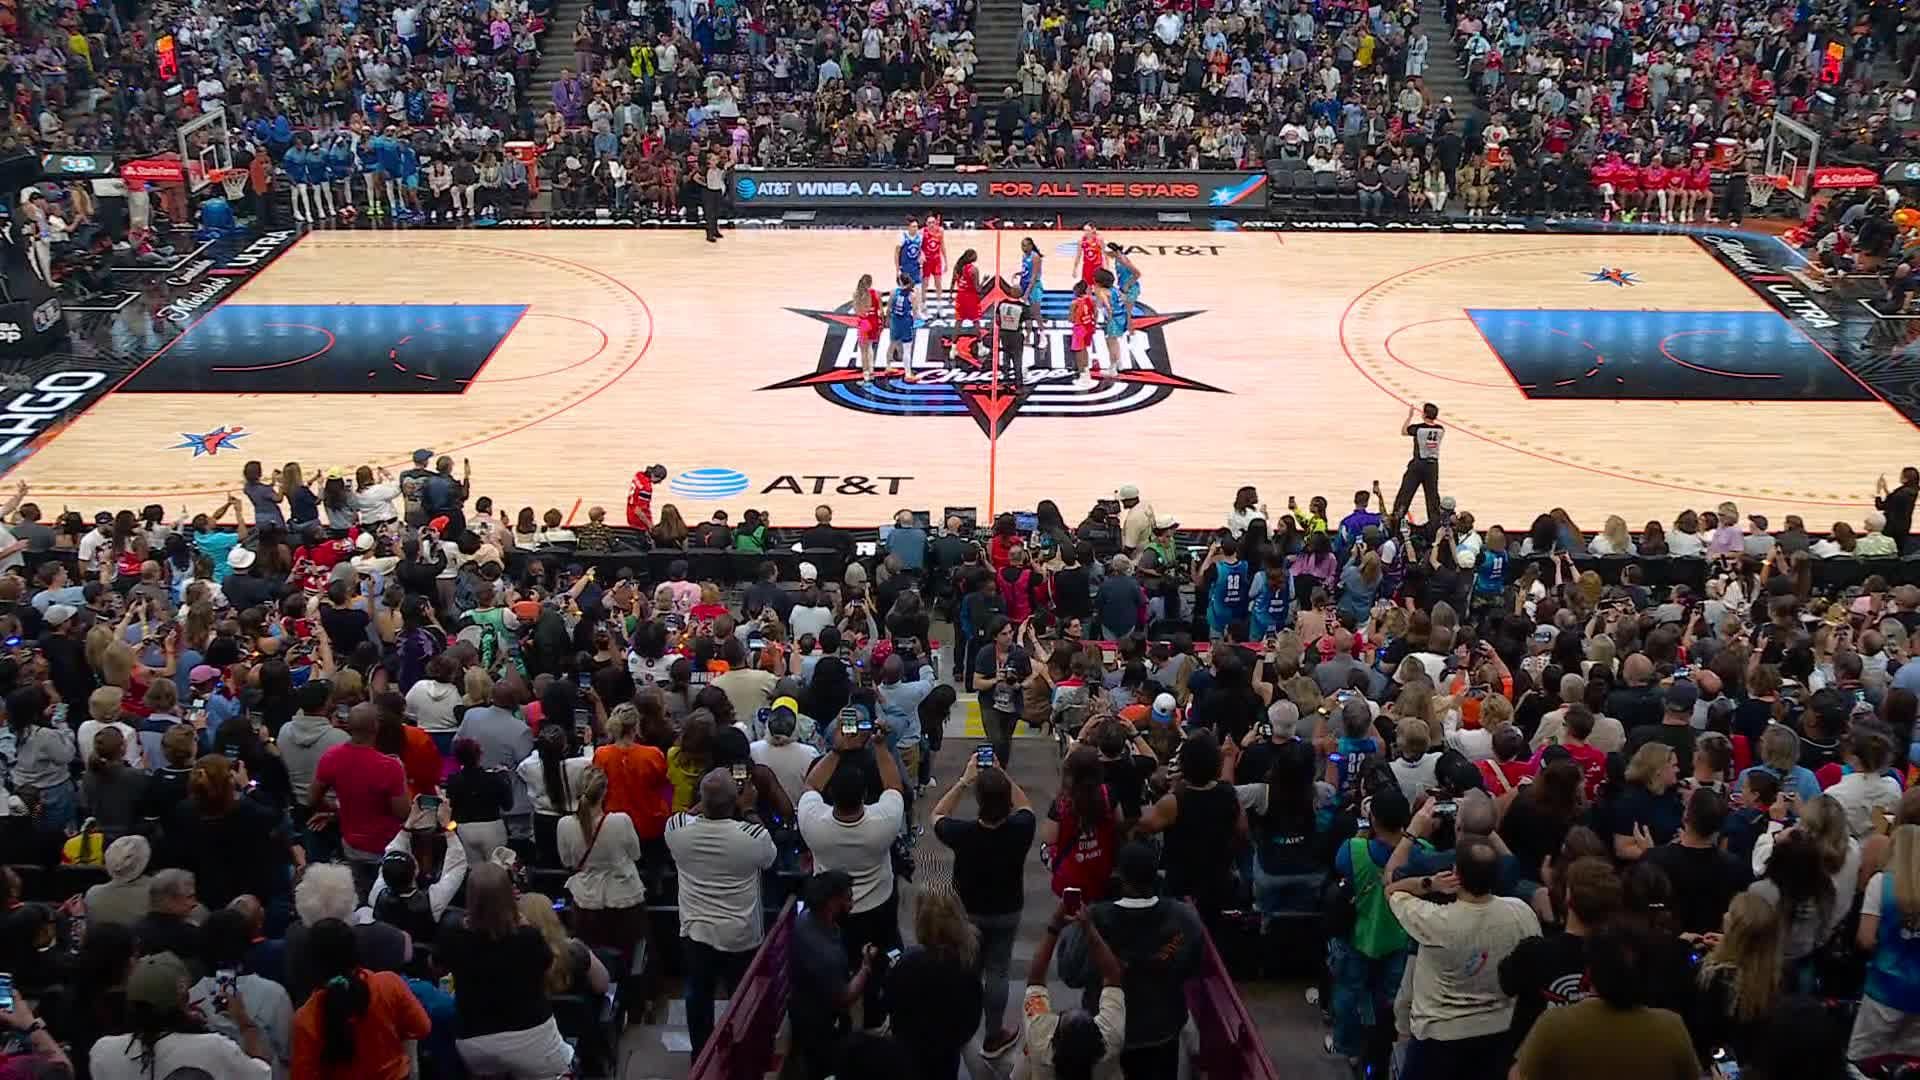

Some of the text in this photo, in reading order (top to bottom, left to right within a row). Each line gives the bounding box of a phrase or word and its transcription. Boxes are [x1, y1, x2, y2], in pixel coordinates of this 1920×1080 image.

[757, 182, 791, 195] AT&T
[797, 182, 862, 195] WNBA
[989, 182, 1032, 196] FOR
[1037, 182, 1078, 196] ALL
[1083, 183, 1124, 197] THE
[1128, 183, 1199, 197] STARS
[156, 229, 296, 321] Michelob ULTRA
[1767, 284, 1840, 328] ULTRA
[759, 475, 914, 495] AT&T
